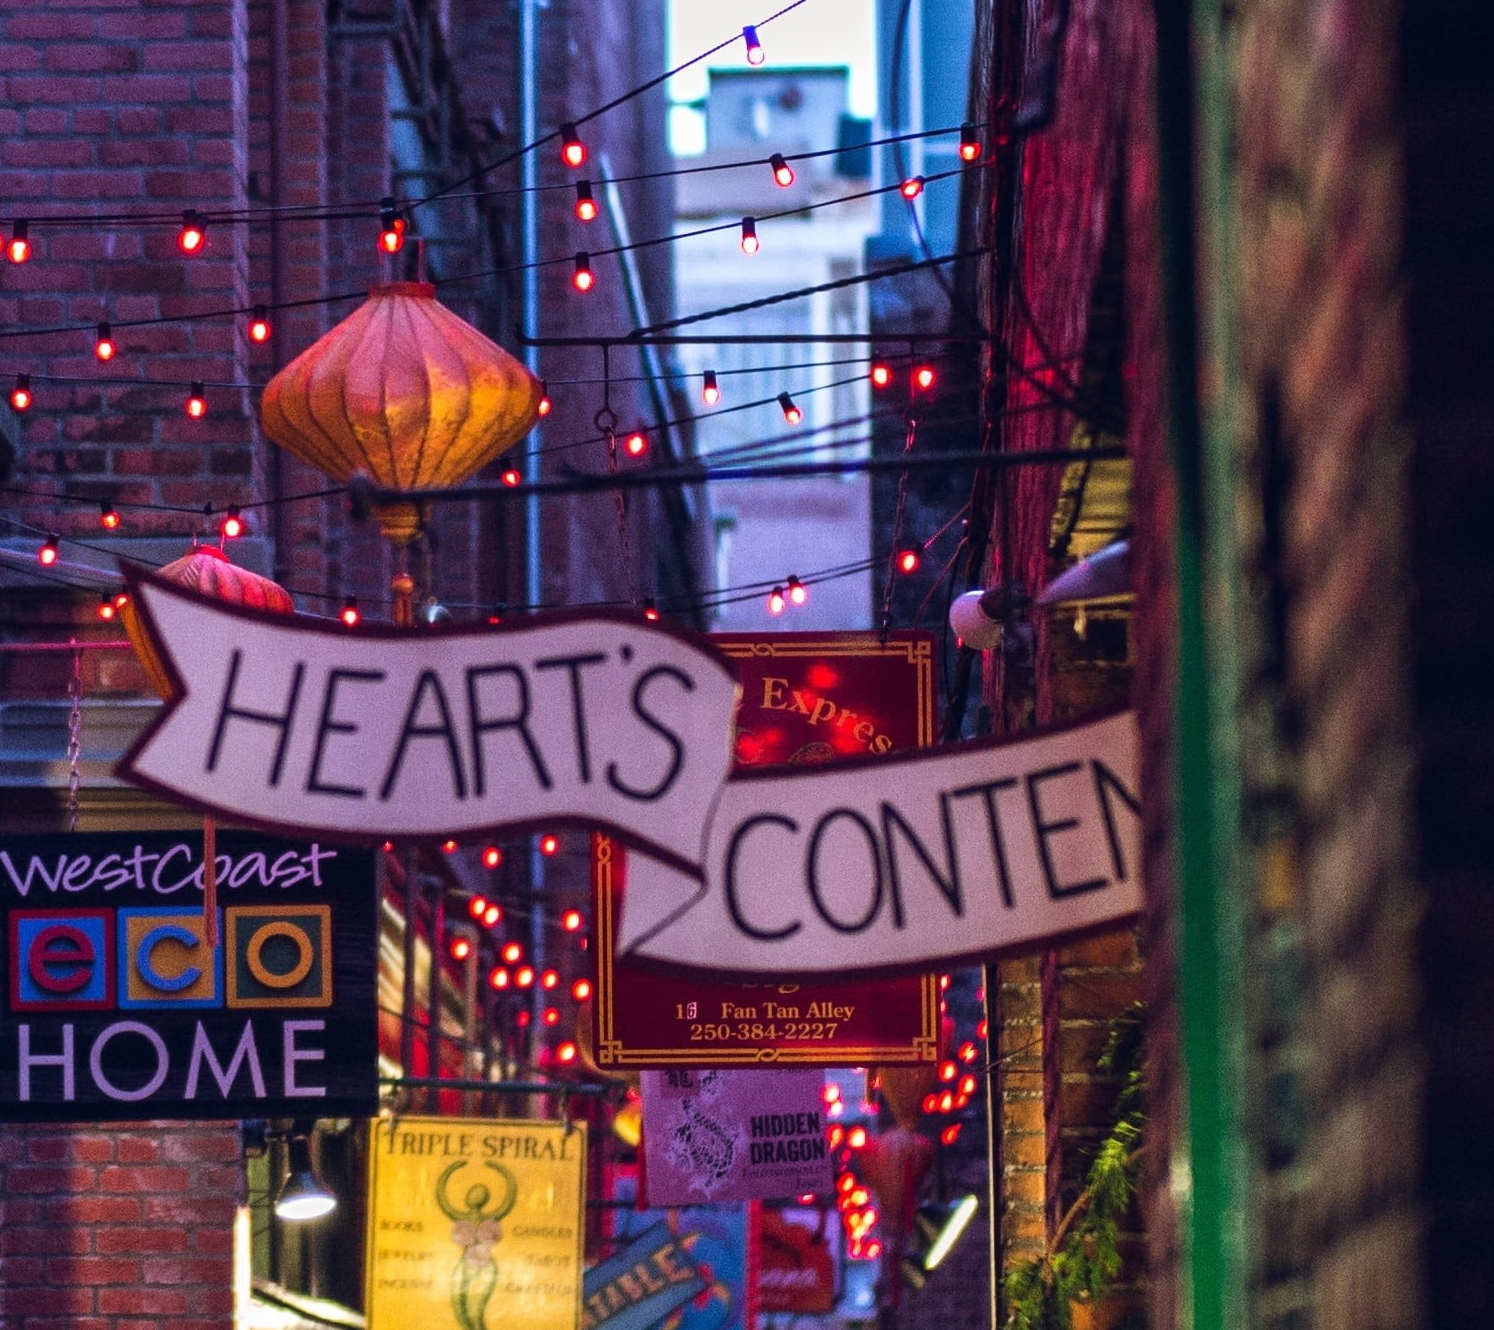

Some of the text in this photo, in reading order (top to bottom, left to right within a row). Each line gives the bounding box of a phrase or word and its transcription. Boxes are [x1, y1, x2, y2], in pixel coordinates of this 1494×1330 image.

[206, 646, 698, 803] HEART'S
[29, 921, 314, 993] eco
[721, 1002, 757, 1020] Fan
[762, 1002, 804, 1020] Tan
[806, 1001, 856, 1022] Alley
[690, 1022, 839, 1042] 250-384-2227
[18, 1019, 327, 1103] HOME
[750, 1112, 821, 1138] HIDDEN
[382, 1130, 576, 1162] TRIPLE SPIRAL
[749, 1137, 826, 1165] DRAGON
[583, 1242, 696, 1330] TABLE
